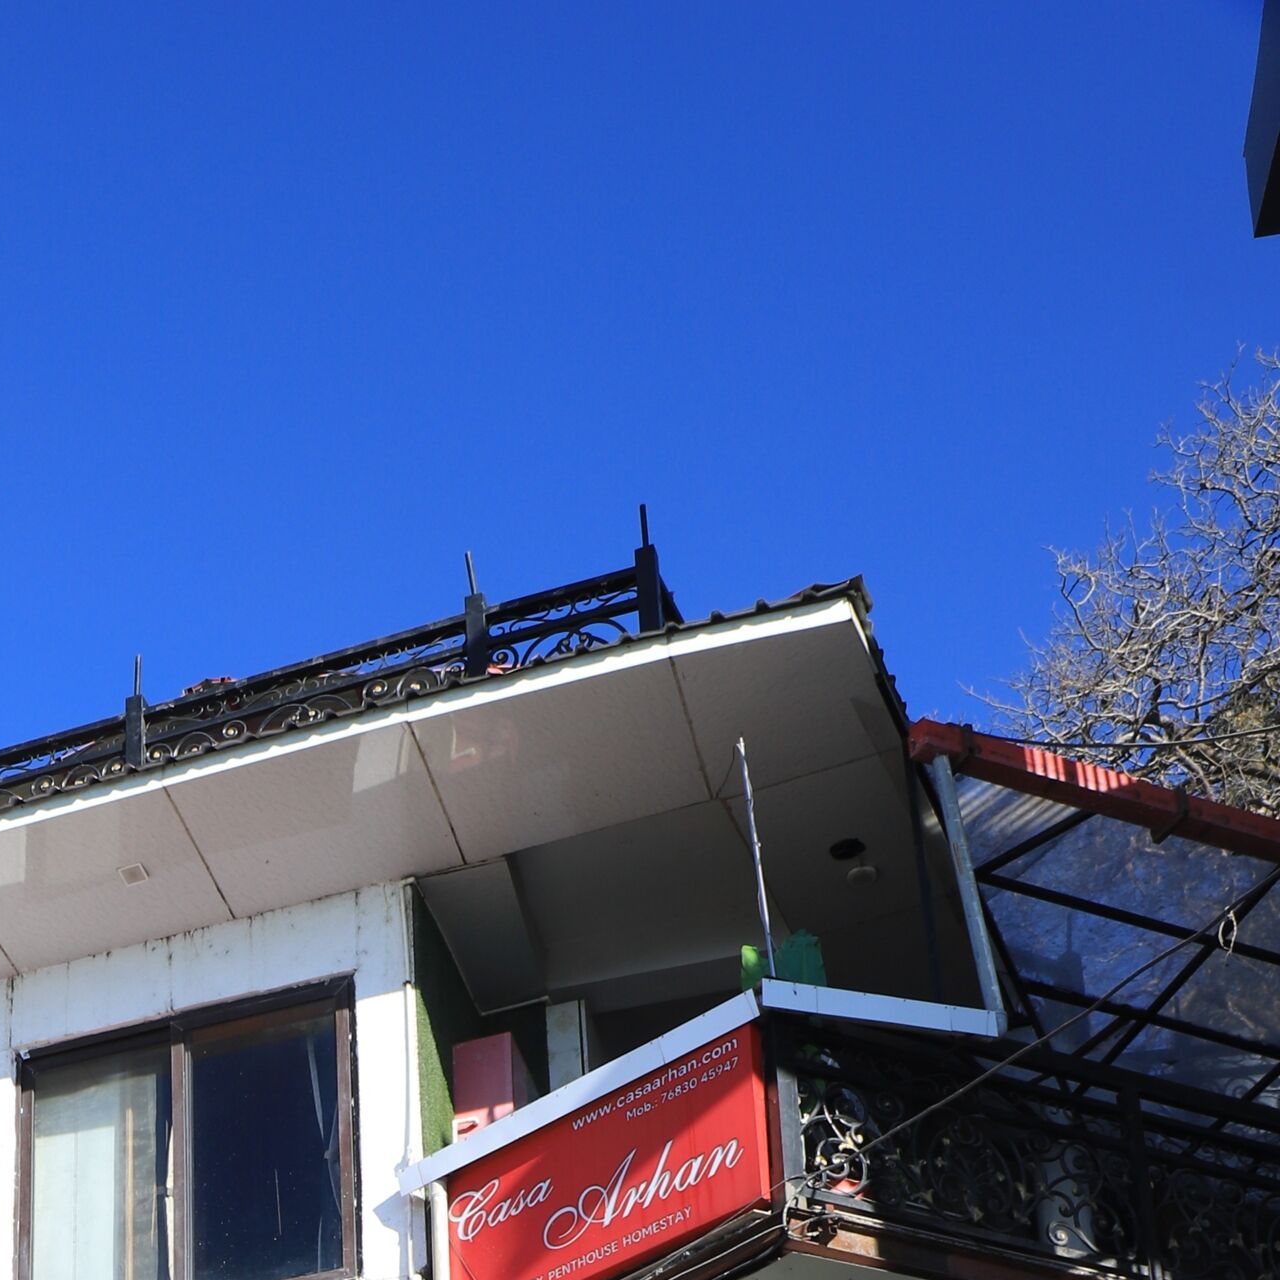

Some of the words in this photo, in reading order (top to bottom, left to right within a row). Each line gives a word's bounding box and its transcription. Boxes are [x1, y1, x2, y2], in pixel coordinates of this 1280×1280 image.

[571, 1038, 739, 1131] www.casaarhan.com
[626, 1098, 658, 1121] Mob.:
[661, 1078, 698, 1104] 76830
[700, 1056, 739, 1087] 45947
[449, 1176, 554, 1242] Casa
[543, 1137, 745, 1251] Arhan
[623, 1206, 693, 1247] HOMESTAY
